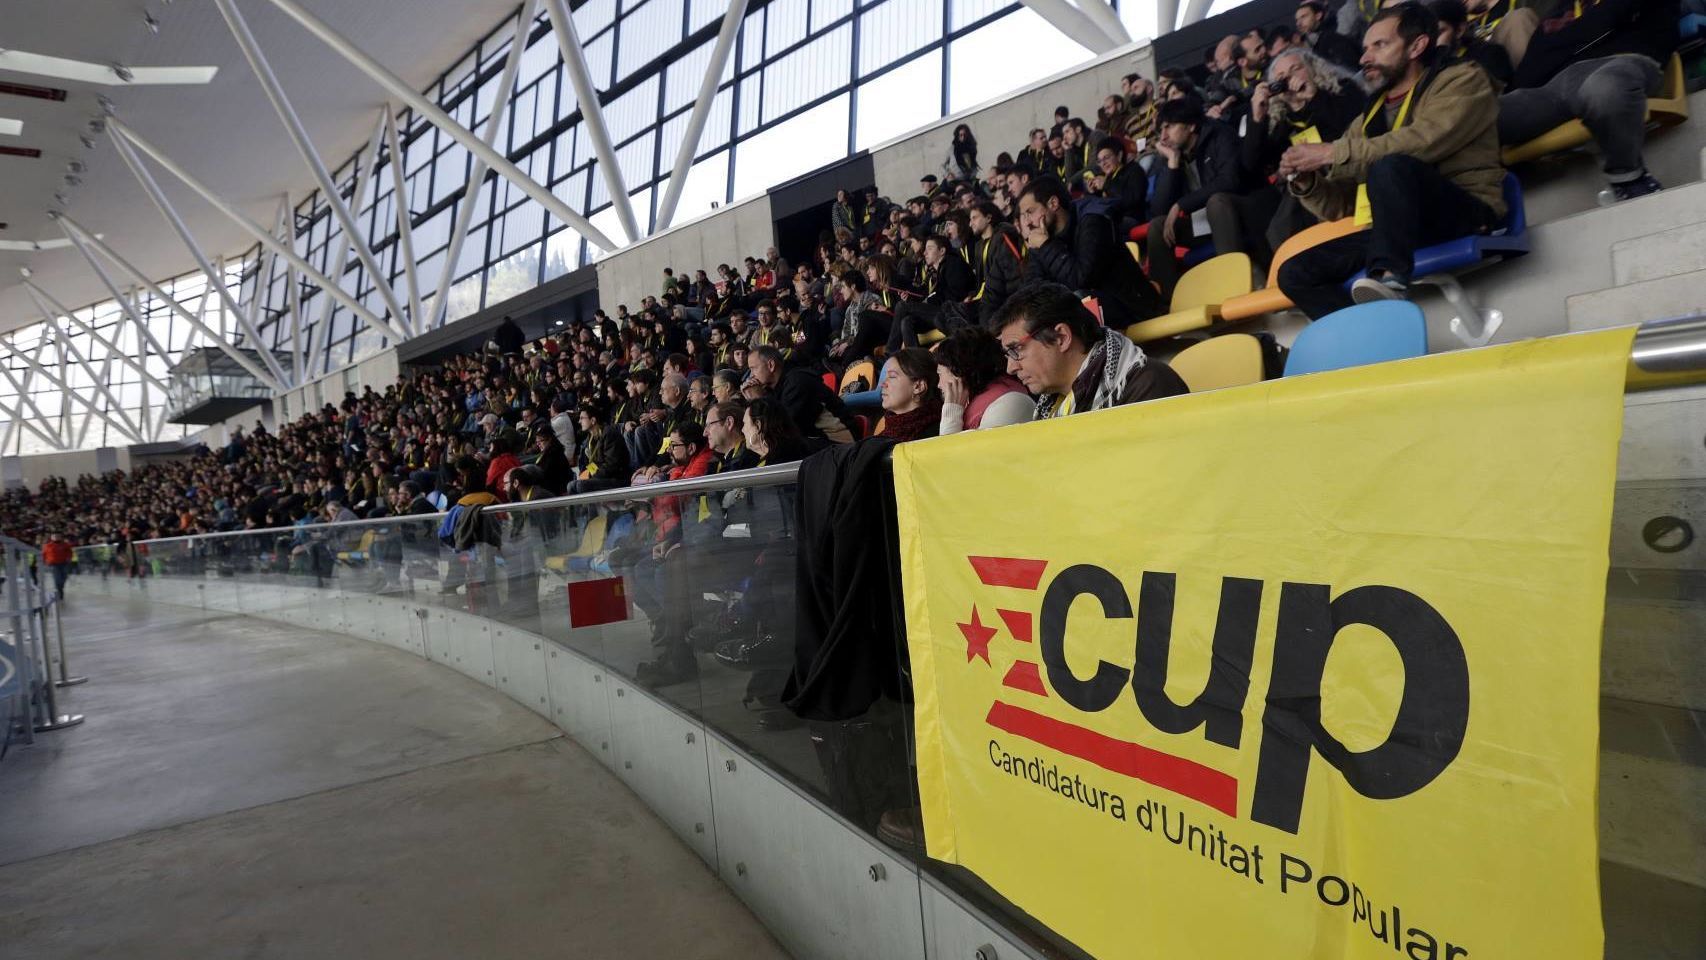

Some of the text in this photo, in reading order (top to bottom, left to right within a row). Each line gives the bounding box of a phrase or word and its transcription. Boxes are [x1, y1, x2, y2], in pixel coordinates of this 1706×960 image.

[1039, 563, 1471, 836] cup
[989, 738, 1469, 960] Candidatura d'Unitat Popular
